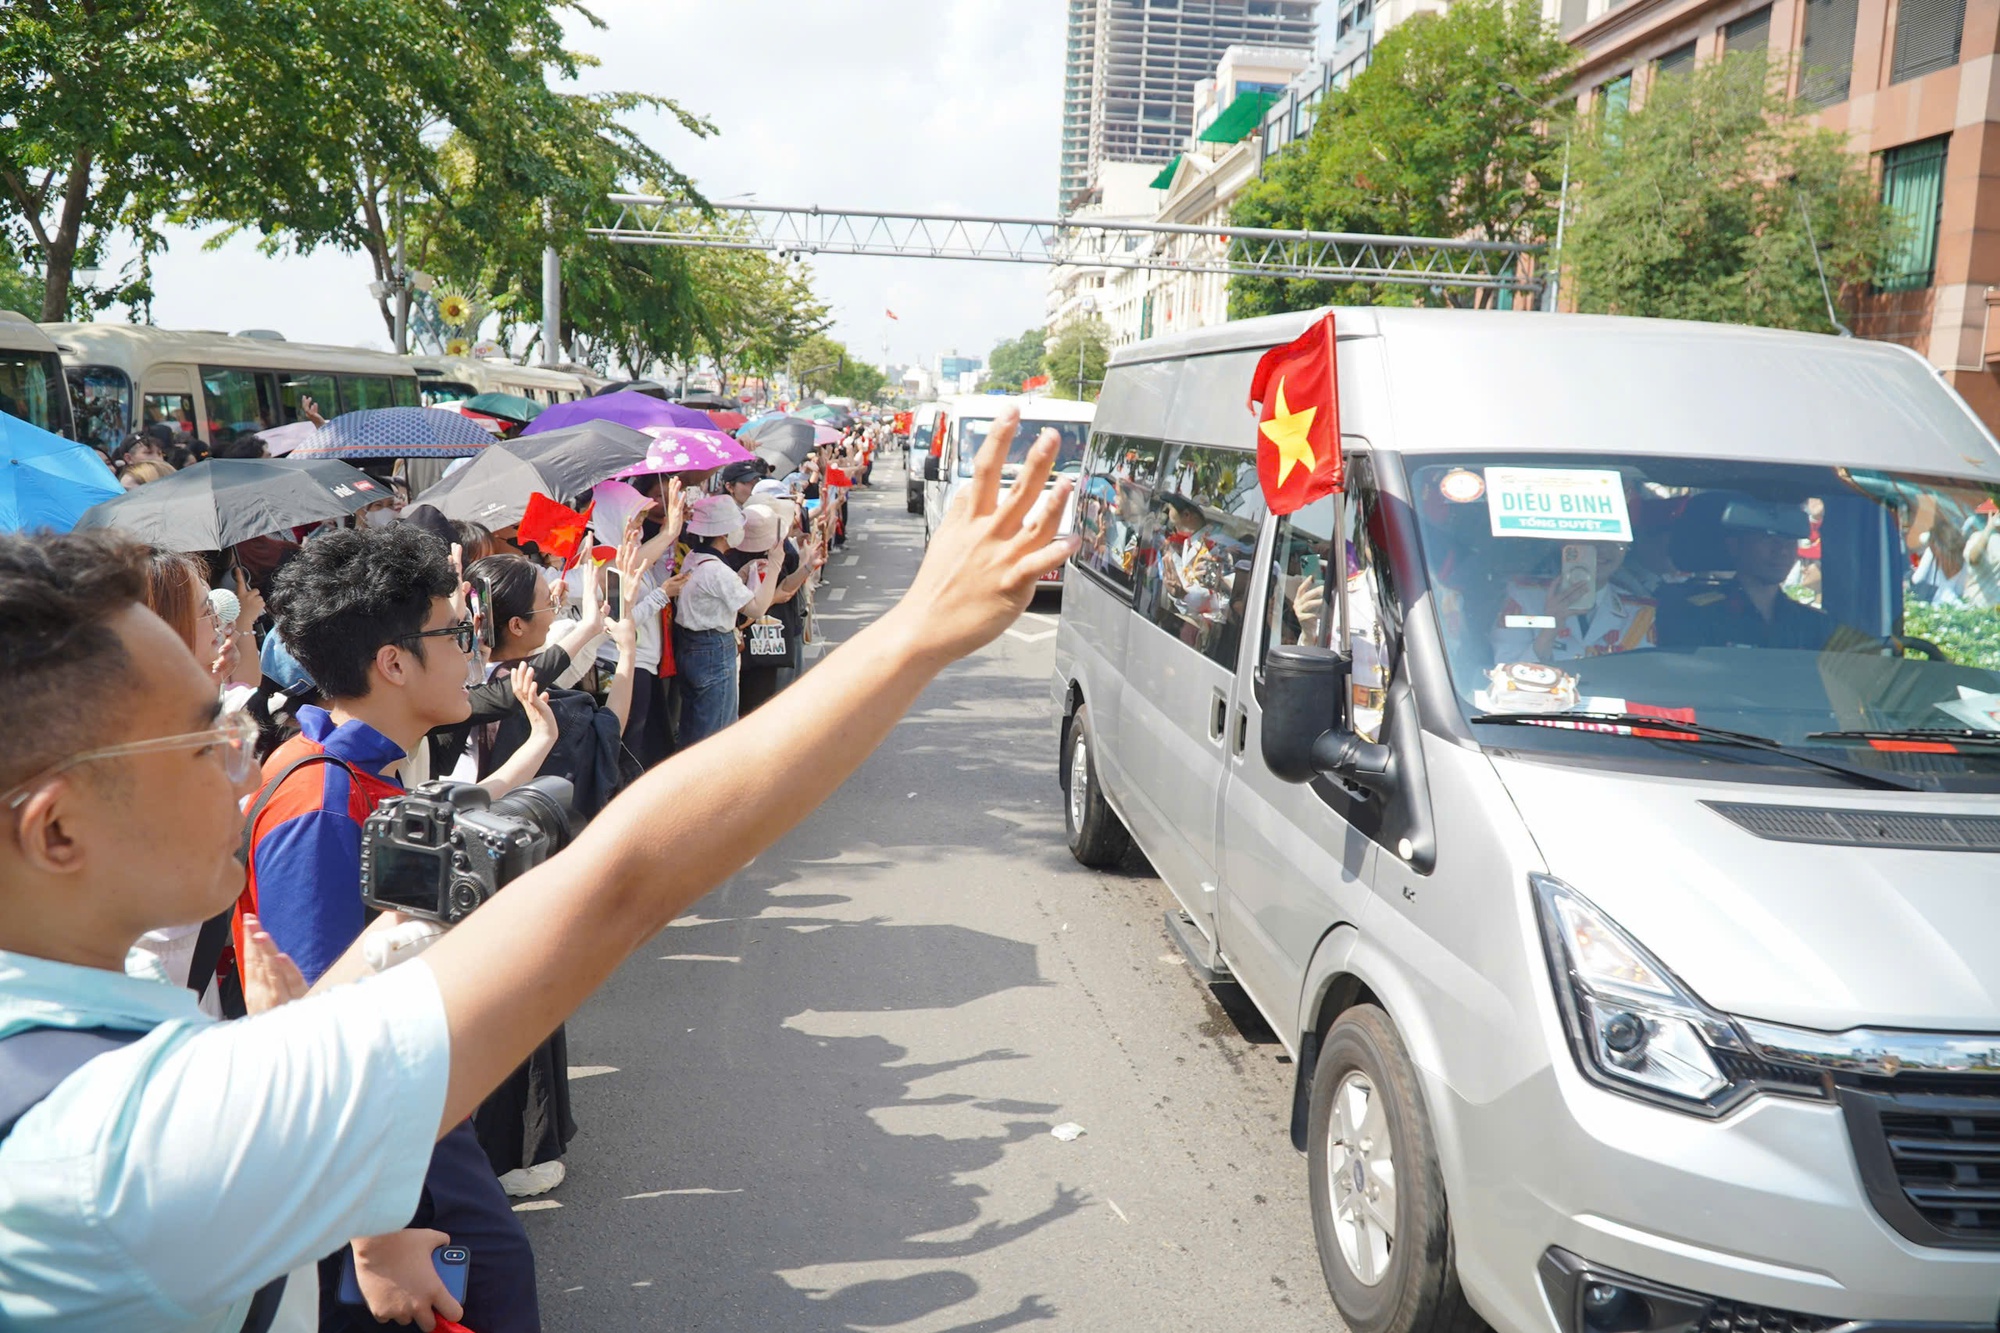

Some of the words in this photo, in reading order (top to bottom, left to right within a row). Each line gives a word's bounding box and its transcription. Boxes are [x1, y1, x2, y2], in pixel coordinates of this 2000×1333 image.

[1560, 494, 1613, 514] BINH
[752, 625, 783, 639] VIET
[751, 639, 785, 654] NAM
